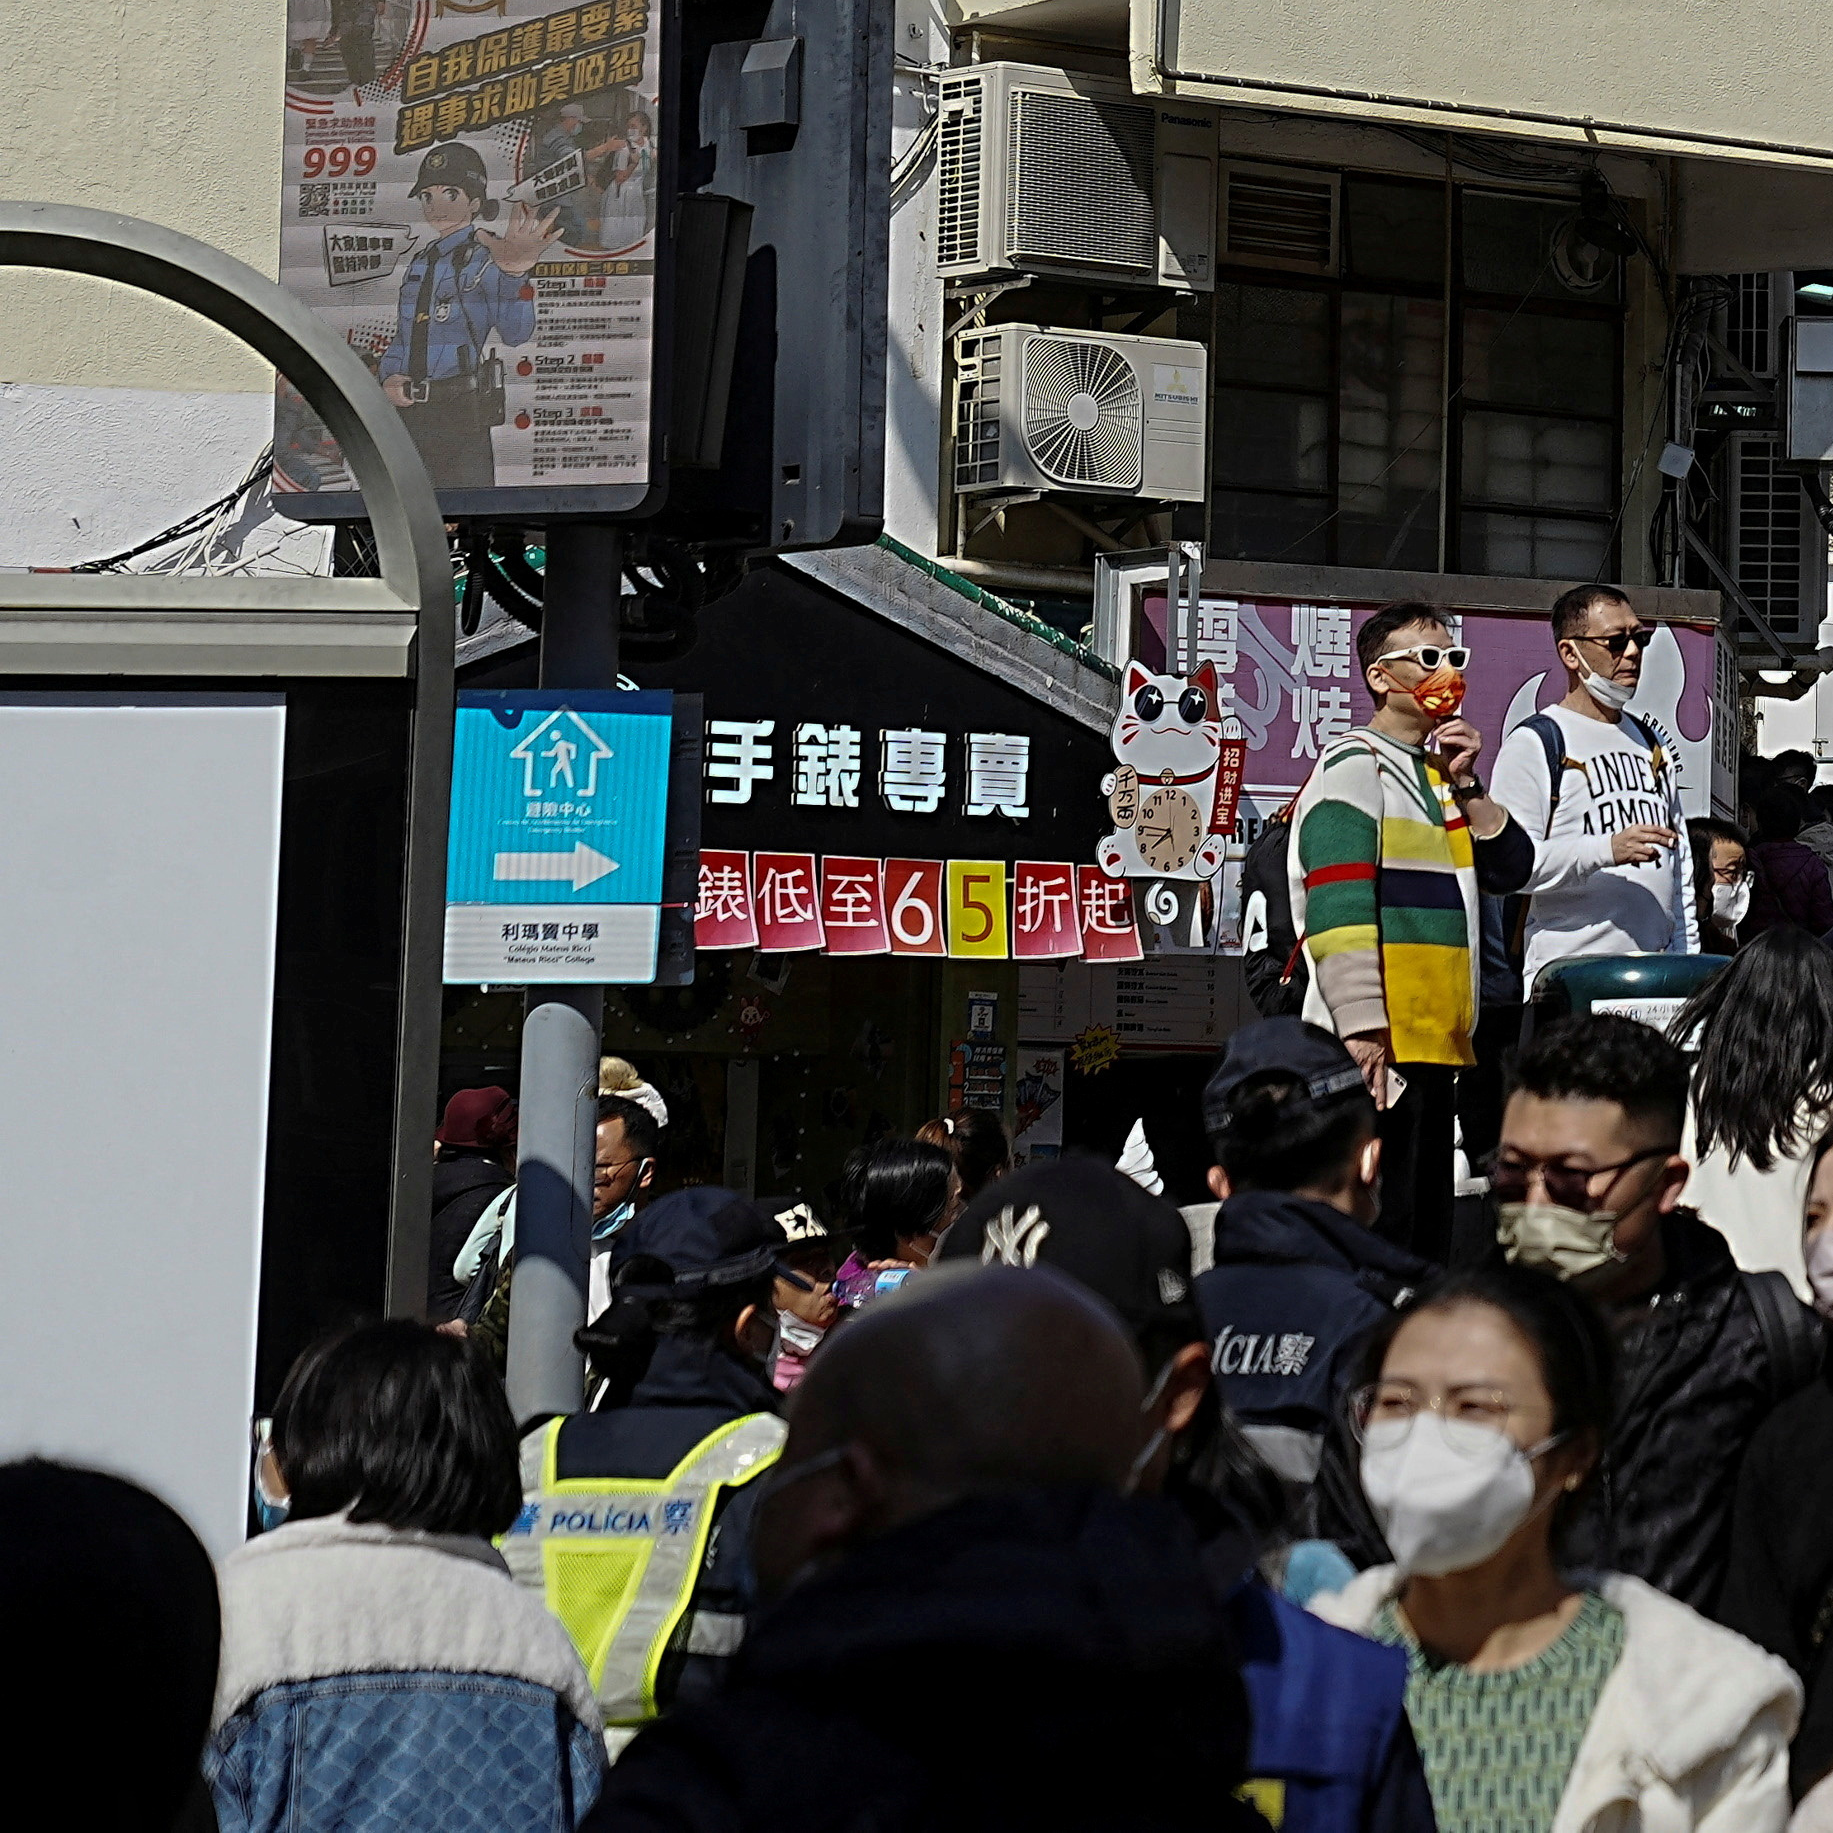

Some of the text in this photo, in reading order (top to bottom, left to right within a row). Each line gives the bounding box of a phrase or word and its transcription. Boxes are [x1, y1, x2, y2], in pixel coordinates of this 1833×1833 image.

[400, 40, 643, 148] 遇事求助莫啞忍
[1161, 112, 1212, 129] Panasonic
[303, 146, 376, 178] 999
[537, 279, 566, 291] Step
[570, 279, 575, 288] 1
[535, 355, 564, 367] Step
[567, 355, 575, 365] 2
[1154, 393, 1198, 403] MITSUBISHI
[533, 408, 562, 420] Step
[566, 408, 574, 418] 3
[704, 719, 1030, 819] 手錶專賣
[1215, 747, 1240, 825] 招财进宝
[1165, 789, 1176, 800] 12
[1153, 795, 1162, 806] 11
[1181, 795, 1187, 806] 1
[1142, 808, 1154, 819] 10
[1191, 809, 1198, 820] 2
[1137, 825, 1144, 836] 9
[1193, 826, 1200, 837] 3
[1140, 843, 1147, 854] 8
[1188, 843, 1196, 854] 4
[1150, 857, 1156, 867] 7
[1164, 862, 1170, 873] 6
[1178, 857, 1184, 867] 5
[1273, 1331, 1315, 1376] 察
[550, 1502, 650, 1534] POLÍCIA
[663, 1497, 693, 1536] 察
